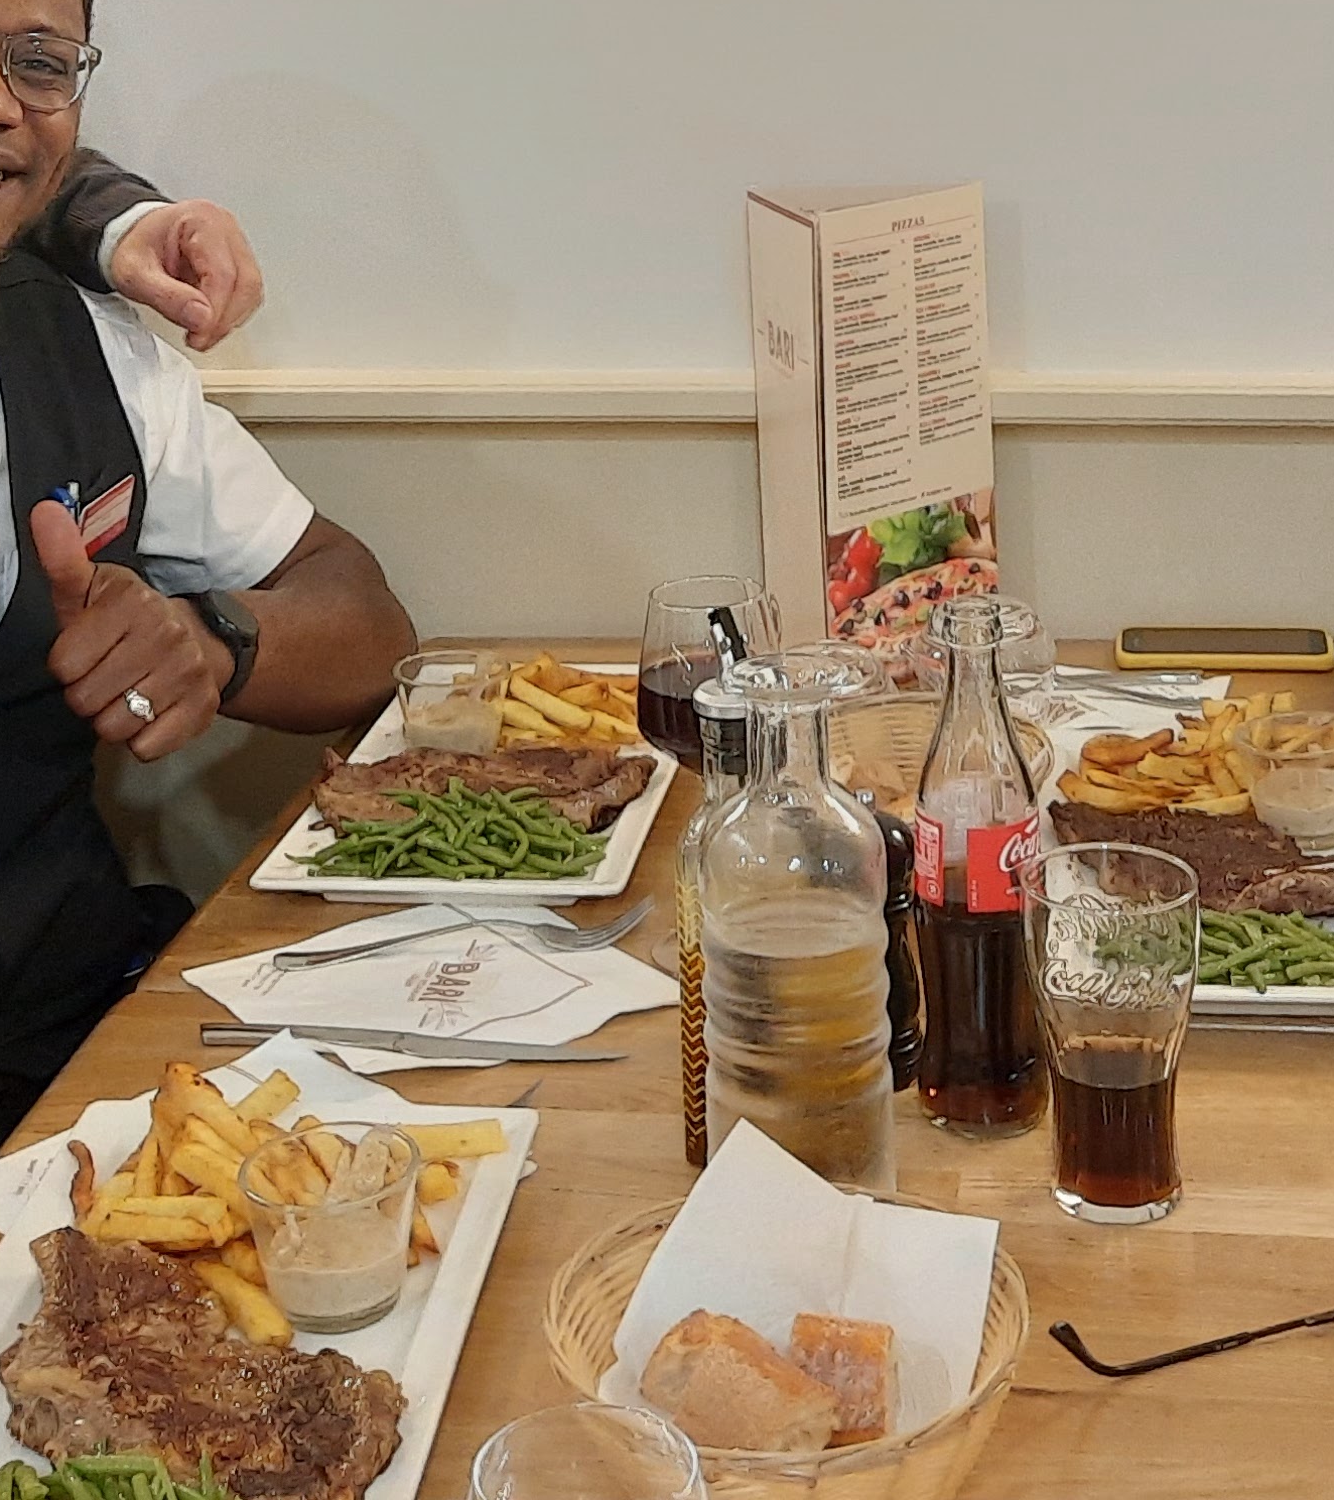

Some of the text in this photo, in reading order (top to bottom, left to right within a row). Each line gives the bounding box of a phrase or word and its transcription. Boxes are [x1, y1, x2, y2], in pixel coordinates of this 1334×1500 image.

[891, 216, 925, 232] PIZZAS
[768, 320, 794, 371] BARI
[418, 963, 480, 1002] BARI
